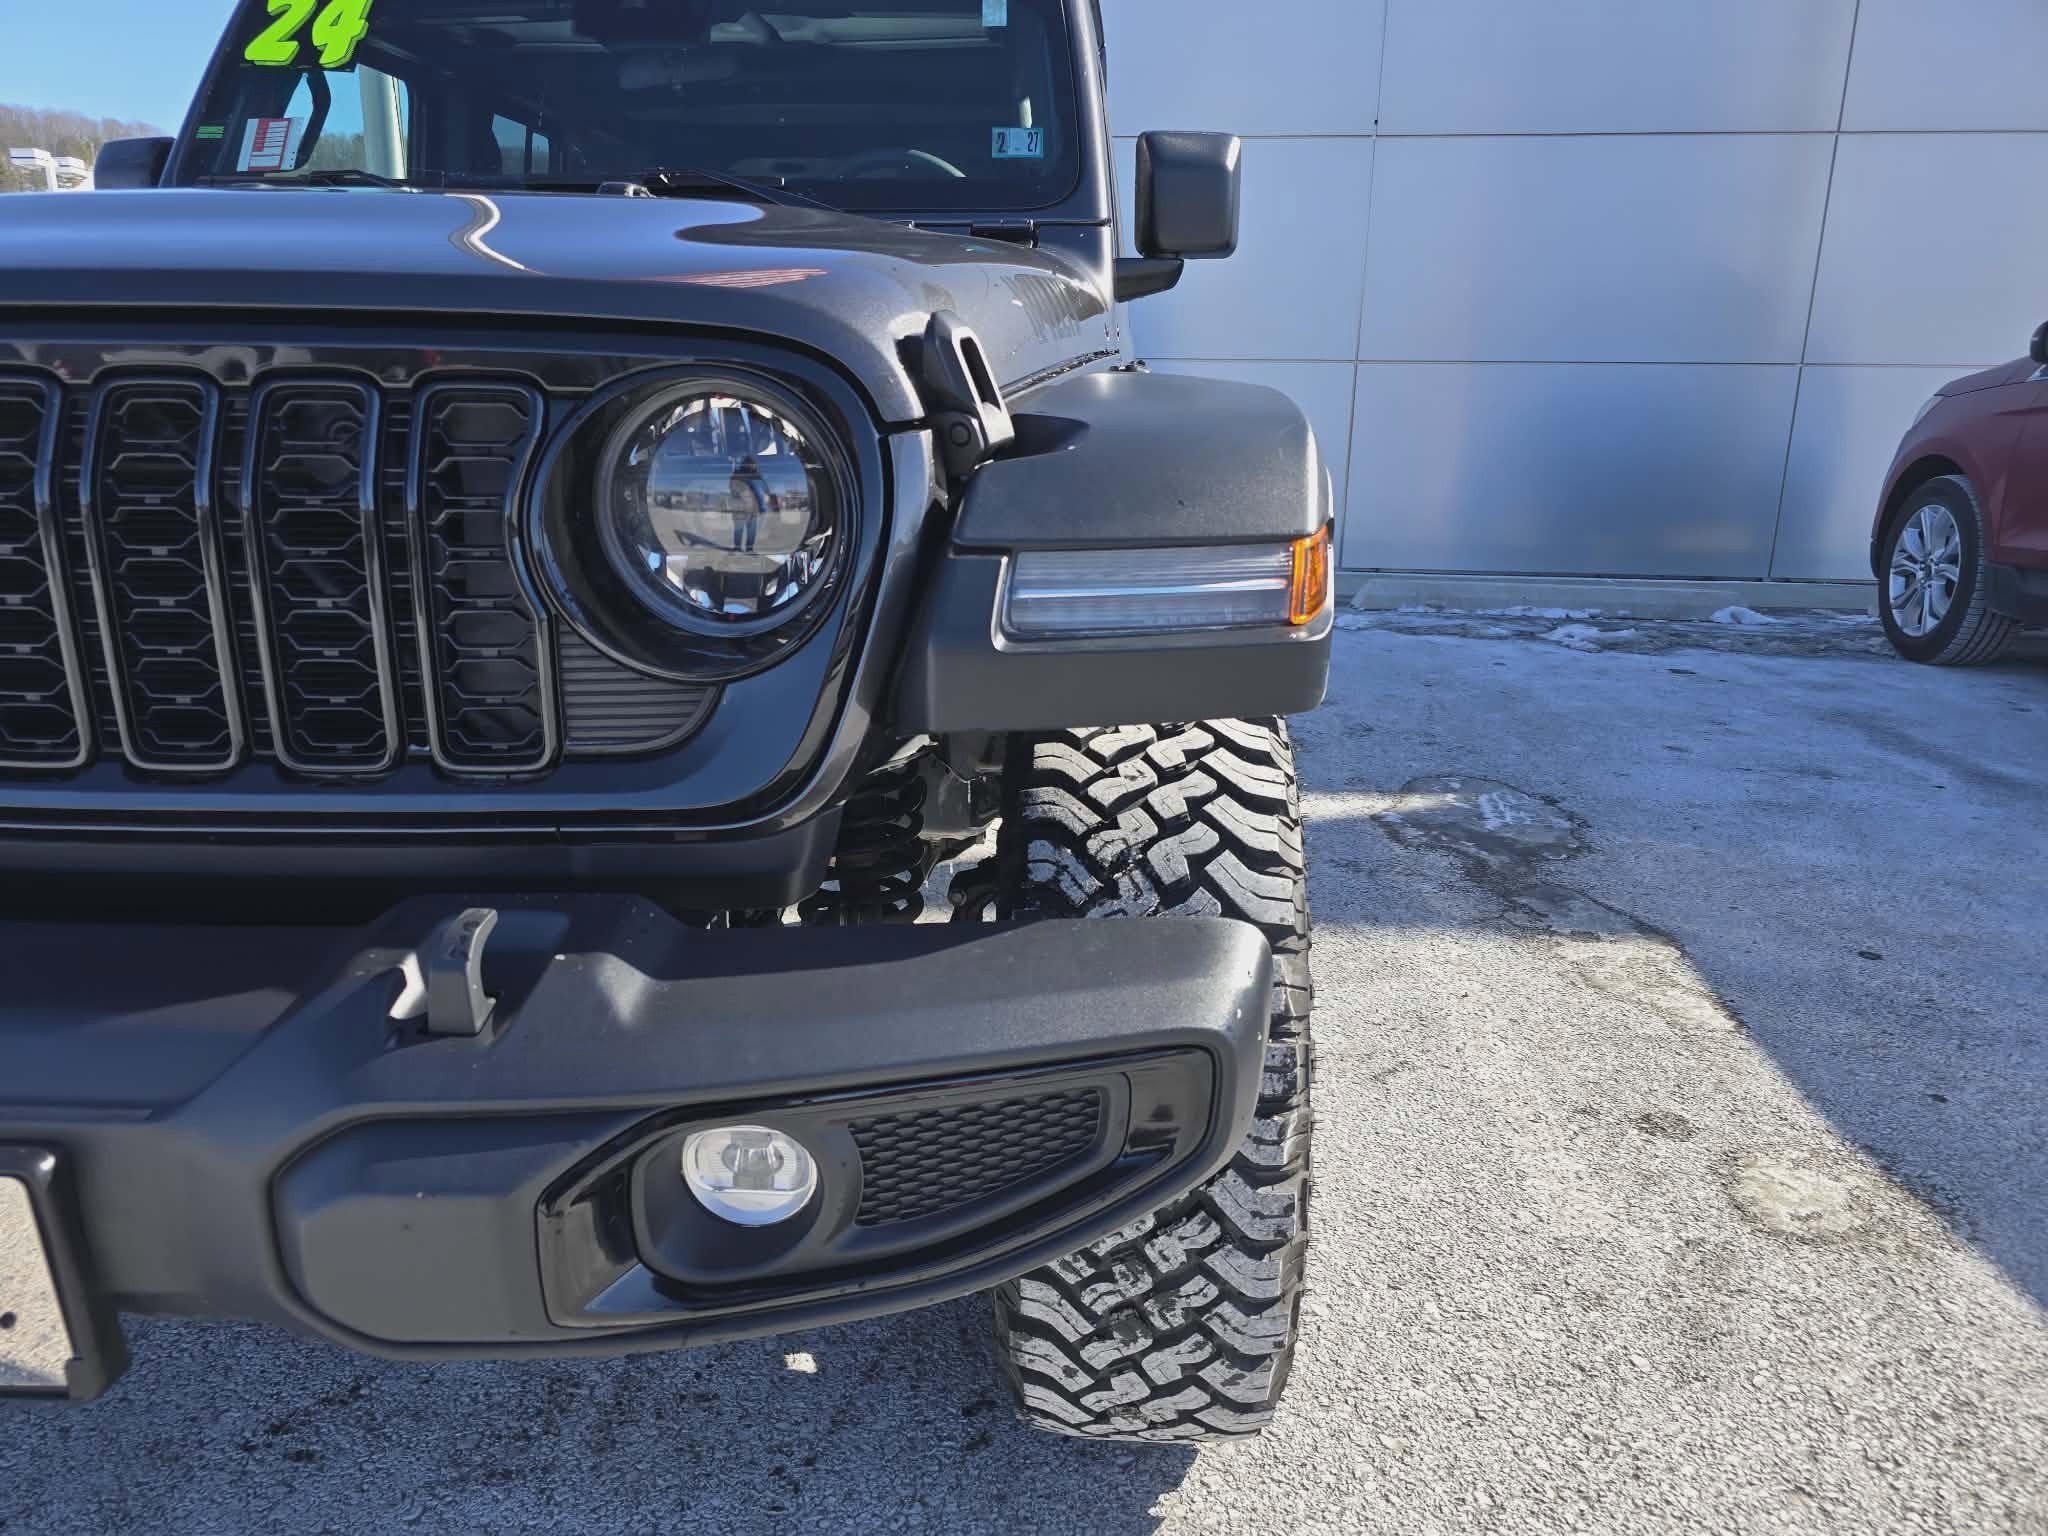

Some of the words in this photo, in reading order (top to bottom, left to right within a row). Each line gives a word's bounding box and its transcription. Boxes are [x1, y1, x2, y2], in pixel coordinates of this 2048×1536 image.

[244, 0, 373, 68] 24
[997, 131, 1006, 152] 2
[1027, 131, 1039, 152] 27
